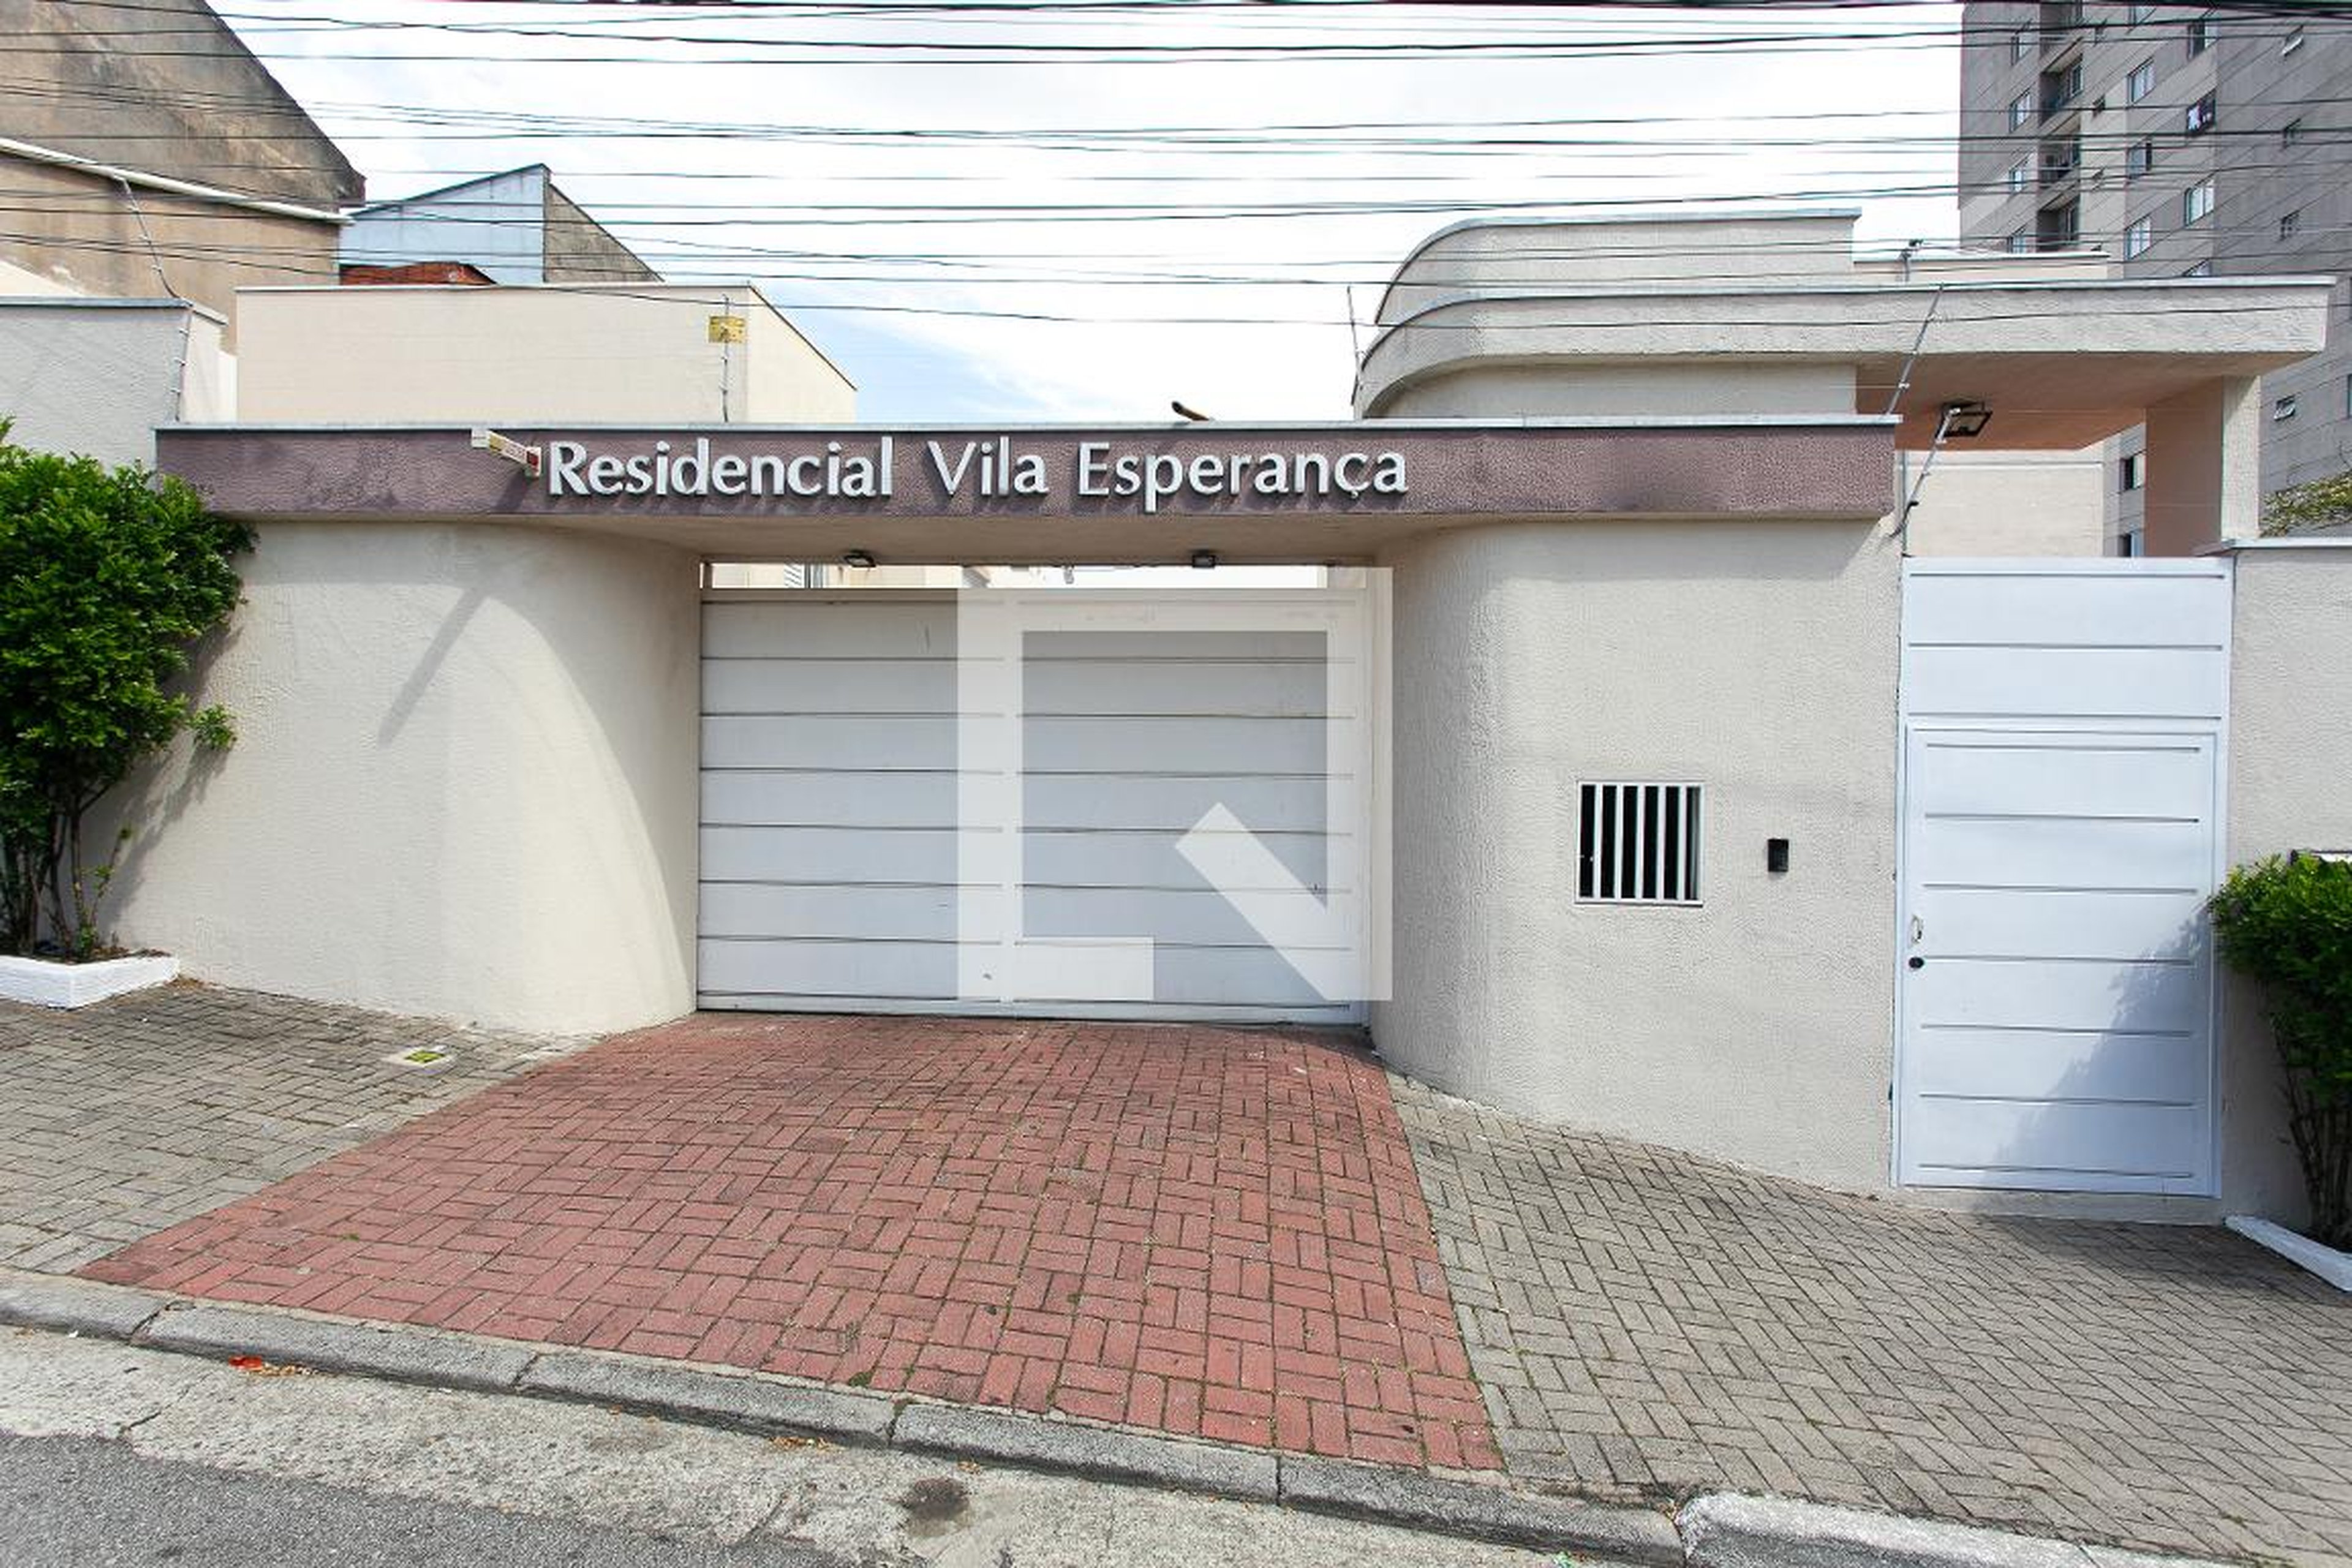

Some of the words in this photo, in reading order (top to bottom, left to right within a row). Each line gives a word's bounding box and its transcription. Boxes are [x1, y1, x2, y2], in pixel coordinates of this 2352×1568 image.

[549, 437, 892, 496] Residencial
[927, 436, 1049, 496] Vila
[1079, 442, 1408, 512] Esperança
